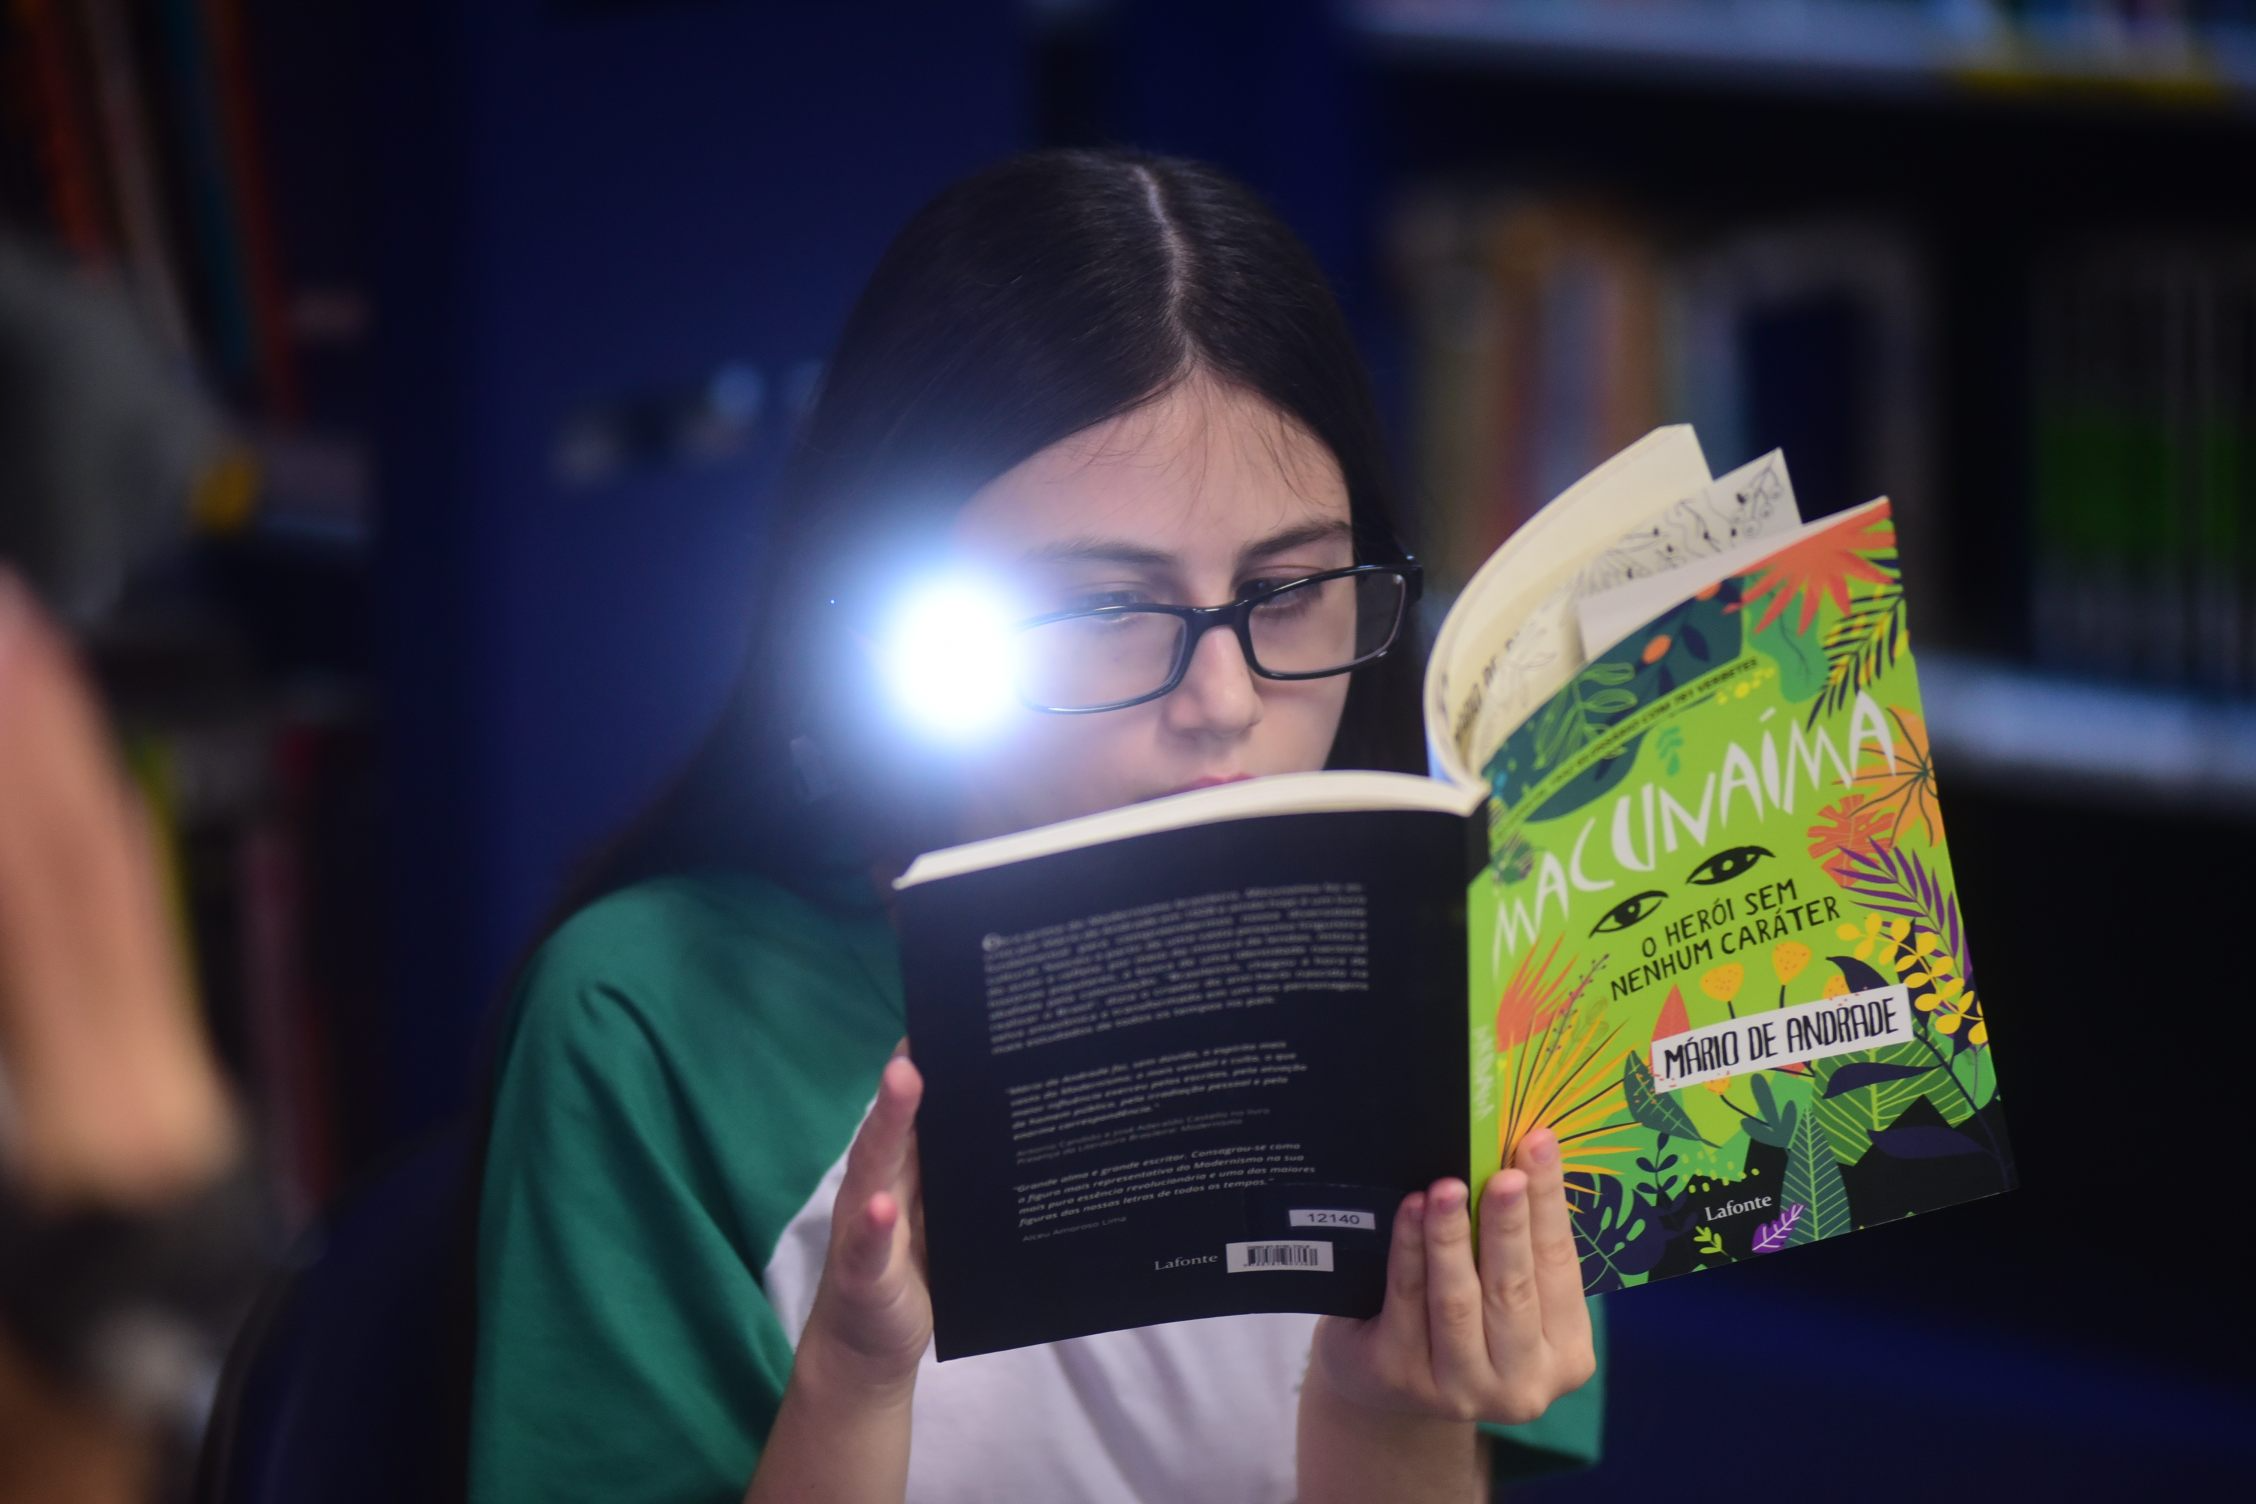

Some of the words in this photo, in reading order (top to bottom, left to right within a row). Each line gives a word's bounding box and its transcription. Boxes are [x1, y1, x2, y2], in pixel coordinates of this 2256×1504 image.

[1490, 690, 1897, 972] MACUNAÍMA
[1641, 931, 1657, 958] O
[1665, 899, 1735, 947] HERÓI
[1744, 878, 1798, 916] SEM
[1610, 937, 1714, 1001] NENHUM
[1721, 894, 1840, 955] CARÁTER
[1664, 1026, 1739, 1079] MÁRIO
[1750, 1019, 1777, 1061] DE
[1787, 997, 1899, 1054] ANDRADE
[1027, 1189, 1061, 1204] figura
[1063, 1183, 1090, 1194] mais
[1176, 1163, 1190, 1171] do
[1193, 1156, 1263, 1169] Modernismo
[1060, 1172, 1089, 1183] alma
[1099, 1161, 1140, 1177] grande
[1191, 1144, 1266, 1159] Consagrou-se
[1018, 1204, 1045, 1215] mais
[1048, 1198, 1075, 1209] pura
[1076, 1188, 1124, 1202] essência
[1126, 1172, 1207, 1192] revolucionária
[1218, 1170, 1244, 1178] uma
[1247, 1167, 1267, 1175] das
[1270, 1166, 1316, 1174] maiores
[1018, 1213, 1059, 1228] figuras
[1060, 1207, 1080, 1217] das
[1082, 1200, 1120, 1212] nossas
[1123, 1194, 1154, 1205] letras
[1157, 1190, 1171, 1198] de
[1174, 1184, 1205, 1194] todos
[1704, 1192, 1773, 1222] Lafonte
[1307, 1213, 1361, 1225] 12140
[1154, 1254, 1219, 1271] Lafonte
